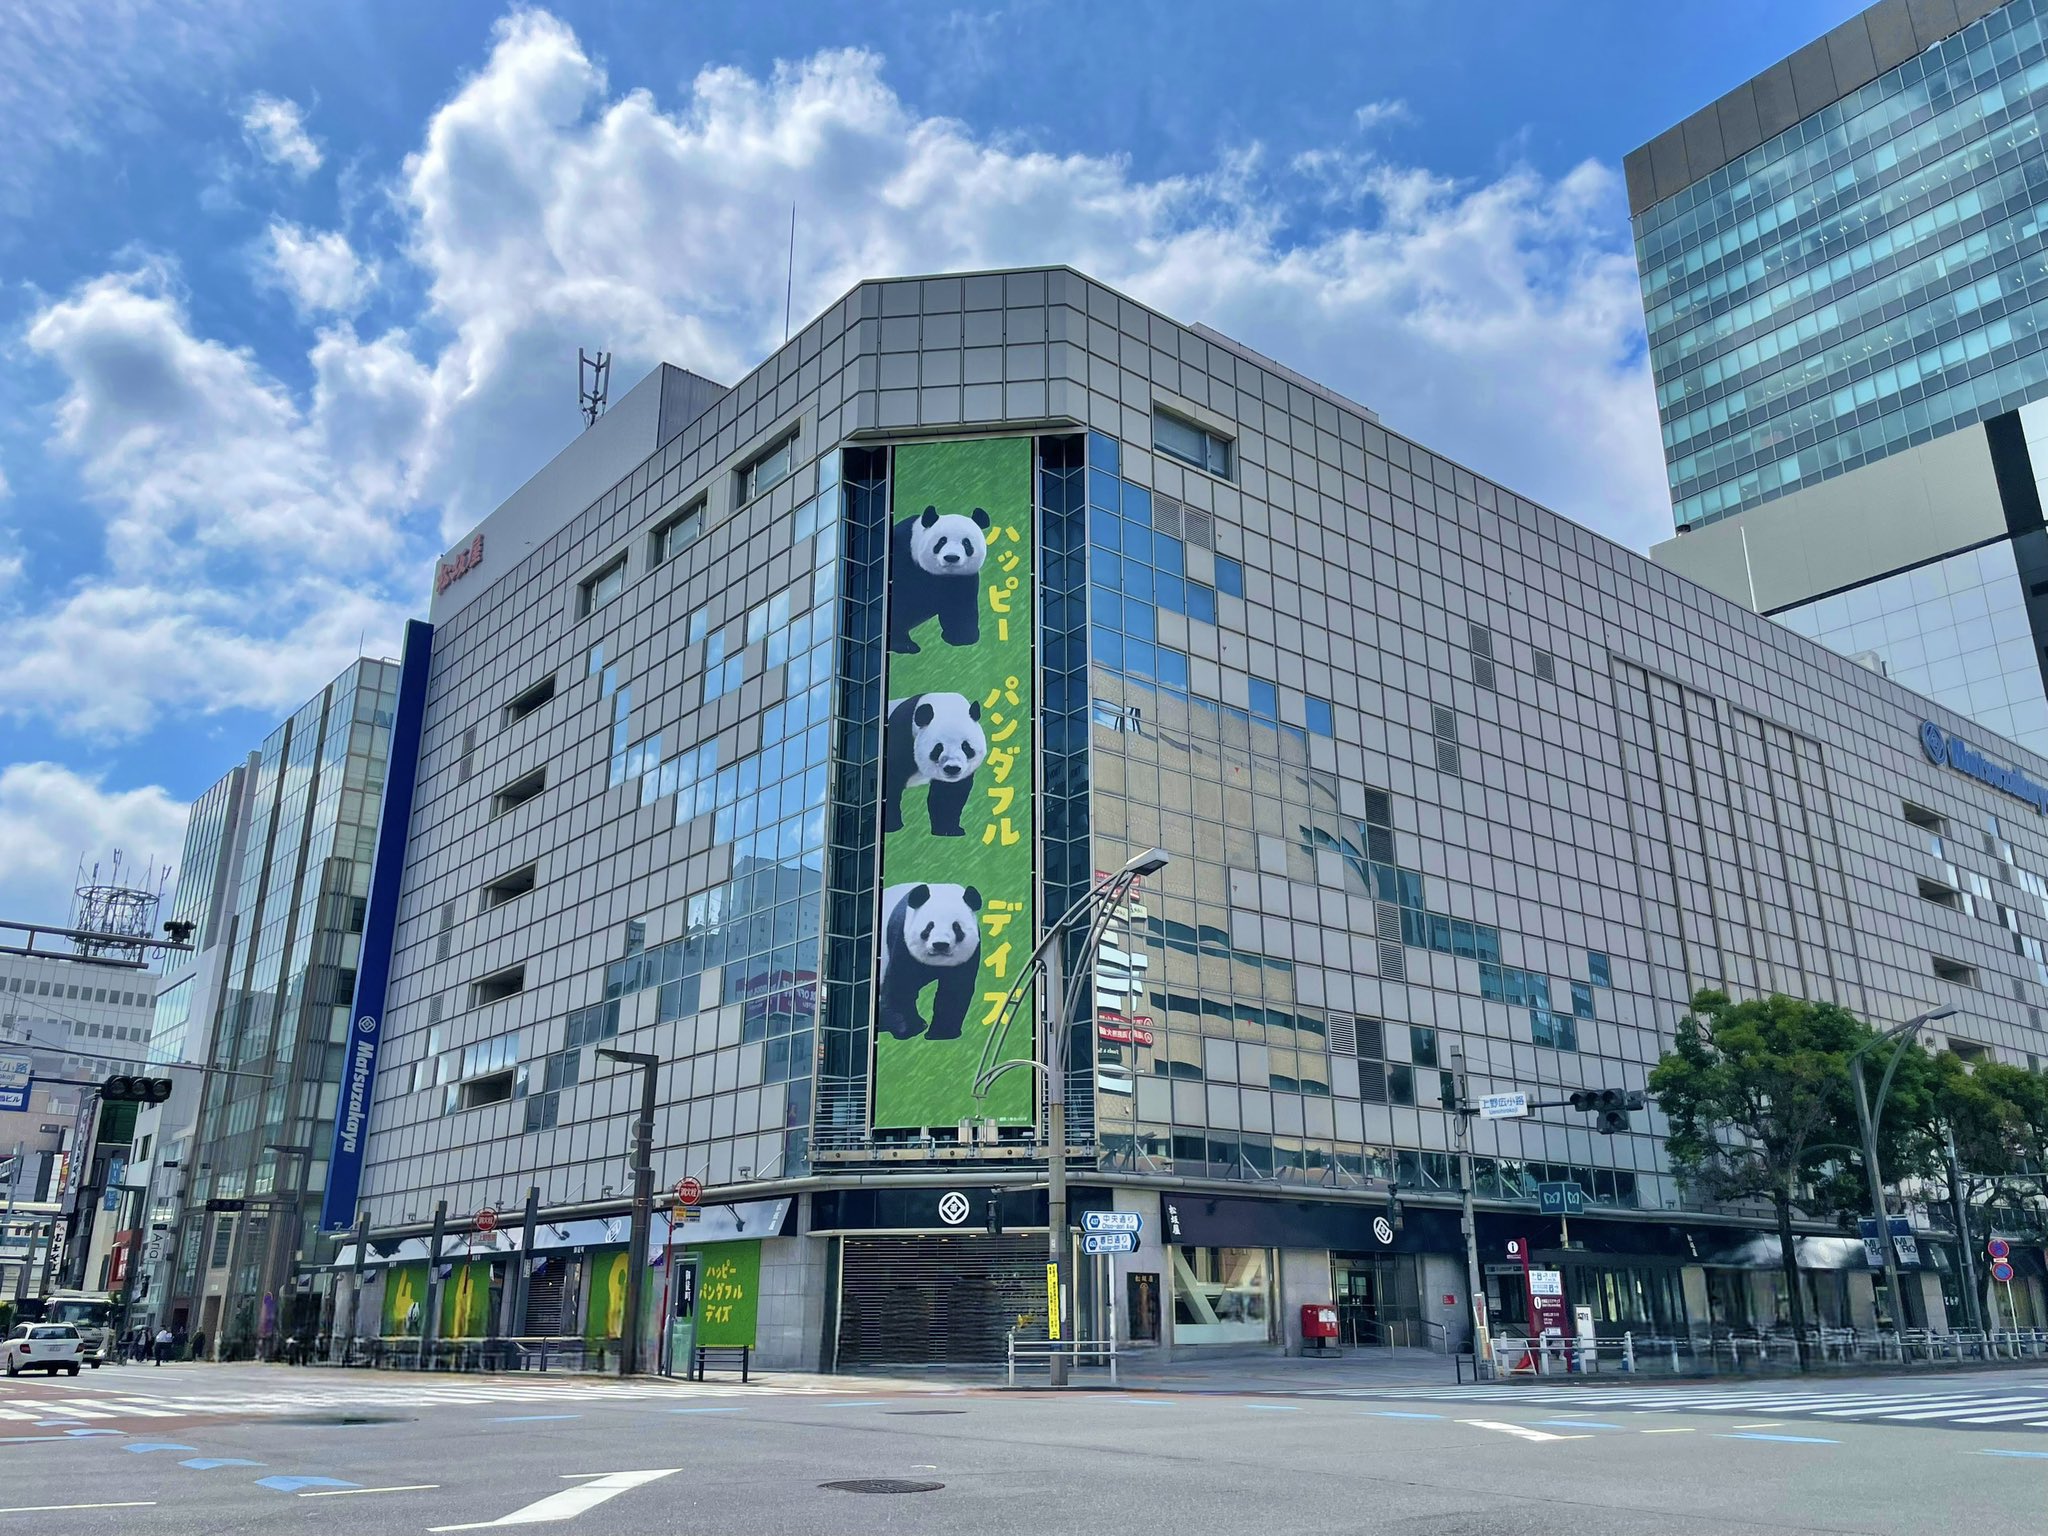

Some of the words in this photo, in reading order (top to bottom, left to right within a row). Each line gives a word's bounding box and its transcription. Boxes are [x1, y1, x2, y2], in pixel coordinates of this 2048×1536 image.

[986, 526, 1020, 641] ハッピー
[982, 675, 1020, 846] パンダフル
[982, 900, 1022, 1025] デイズ
[341, 1040, 374, 1153] Matsuzakaya
[1482, 1095, 1524, 1109] 上野広小路
[1102, 1215, 1134, 1224] 中央通り
[1168, 1204, 1181, 1235] 松坂屋
[150, 1233, 163, 1258] Aria
[706, 1259, 736, 1279] ハッピー
[699, 1283, 743, 1301] パンダフル
[706, 1304, 733, 1323] デイズ
